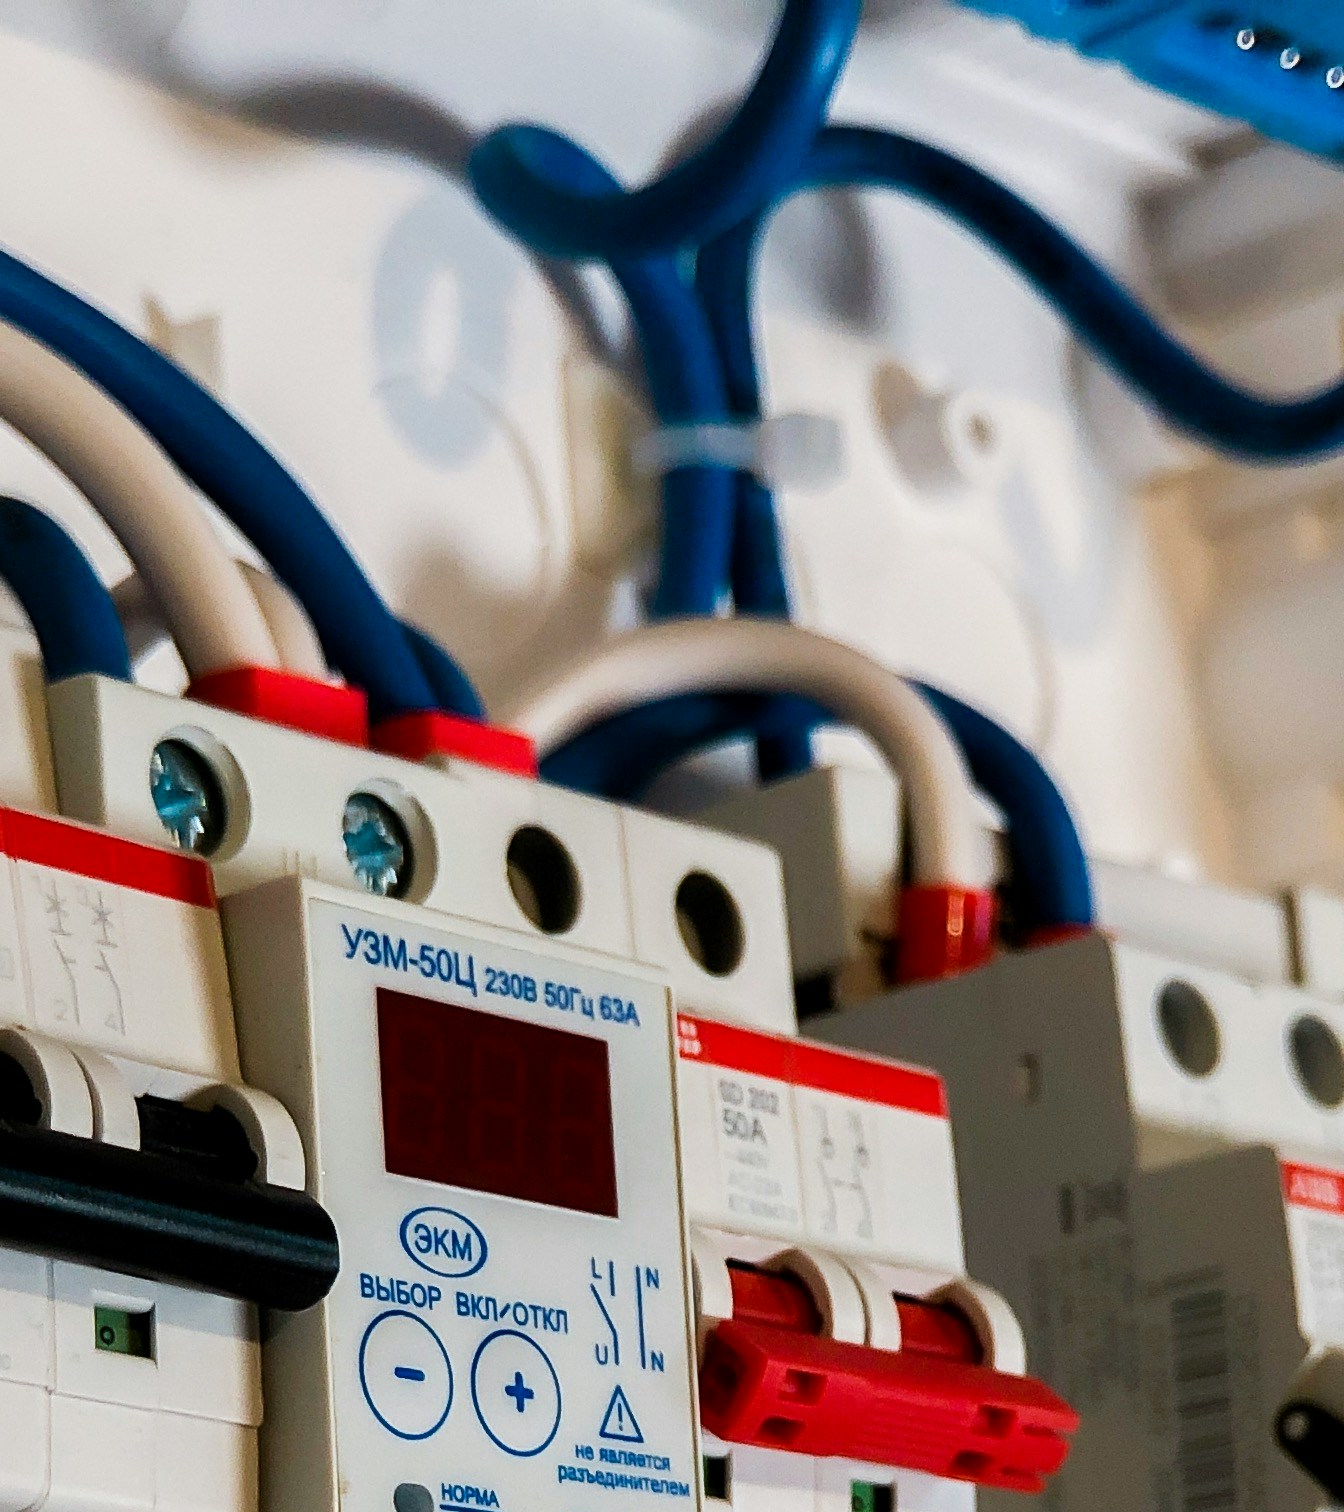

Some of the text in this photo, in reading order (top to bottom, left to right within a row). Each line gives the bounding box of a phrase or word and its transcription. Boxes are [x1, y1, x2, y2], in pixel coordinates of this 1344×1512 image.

[484, 966, 538, 1003] 230В
[543, 981, 595, 1021] 50Гц
[599, 993, 641, 1028] 63А
[413, 1222, 474, 1263] ЭКМ
[645, 1267, 660, 1290] N
[359, 1272, 569, 1335] ВЫБОР ВКЛ/ОТКЛ
[595, 1343, 609, 1365] U
[650, 1350, 665, 1373] N
[598, 1449, 671, 1472] является
[557, 1464, 691, 1498] разъединителем
[440, 1483, 501, 1509] НОРМА
